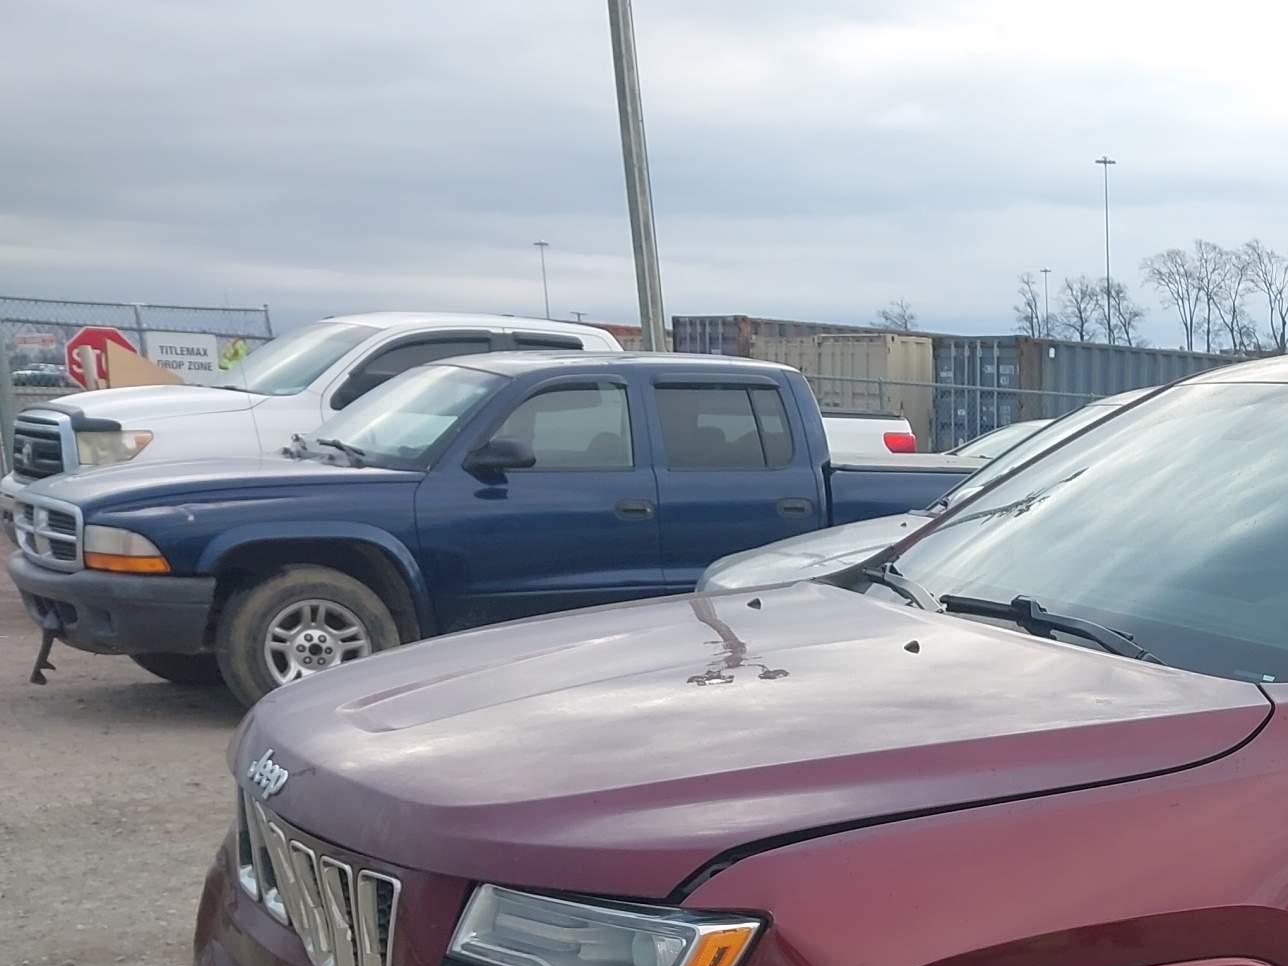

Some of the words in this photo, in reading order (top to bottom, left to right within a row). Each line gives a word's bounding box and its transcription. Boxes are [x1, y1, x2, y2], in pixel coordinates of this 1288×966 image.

[159, 345, 208, 357] TITLEMAX
[188, 361, 213, 371] ZONE
[247, 749, 288, 799] Jeep
